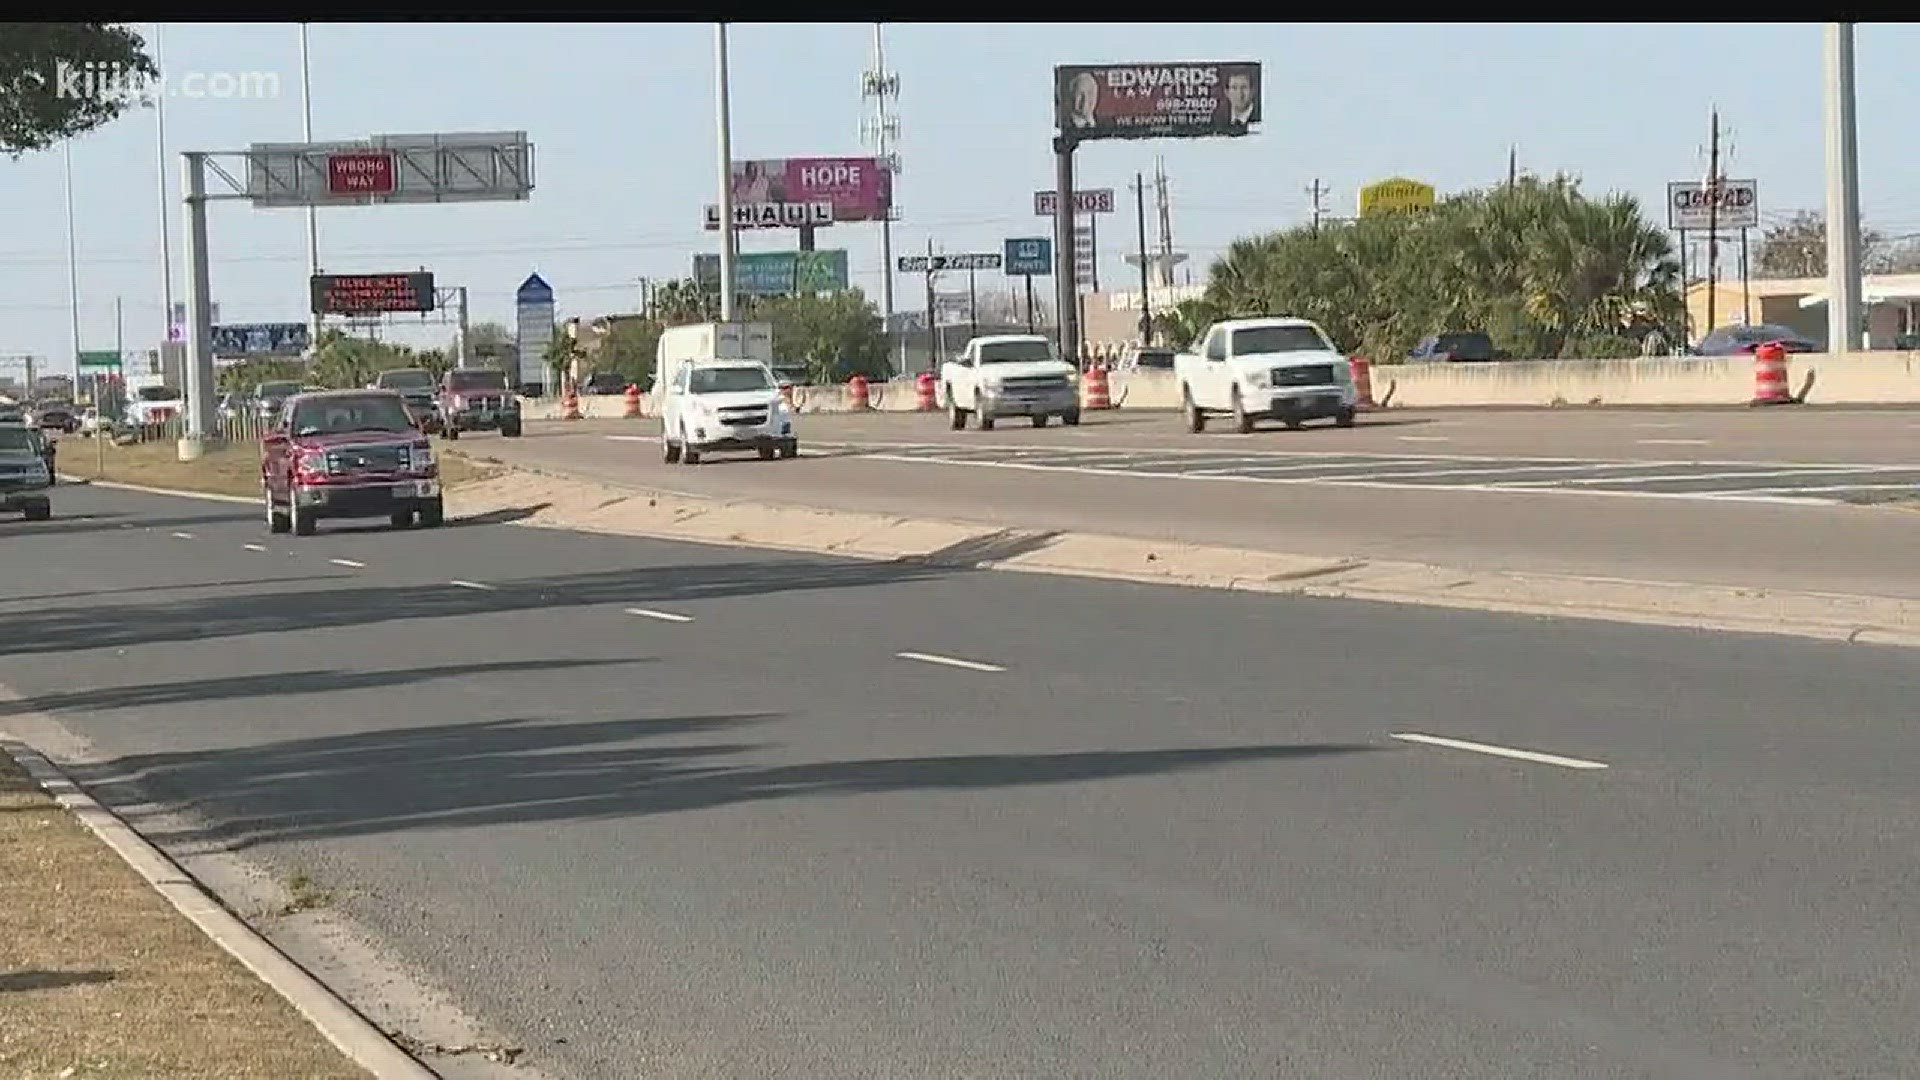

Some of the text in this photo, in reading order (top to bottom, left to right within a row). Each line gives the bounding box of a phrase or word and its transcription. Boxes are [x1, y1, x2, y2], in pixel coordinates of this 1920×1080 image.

[1107, 67, 1219, 87] EDWARDS
[1113, 83, 1209, 98] LAW FIRM
[1116, 115, 1133, 126] WE
[1135, 115, 1167, 126] KNOW
[1189, 113, 1212, 125] LAW
[335, 160, 385, 173] WRONG
[346, 175, 375, 187] WAY
[801, 166, 862, 187] HOPE
[1041, 193, 1109, 211] PINOS
[708, 204, 828, 221] UHAUL
